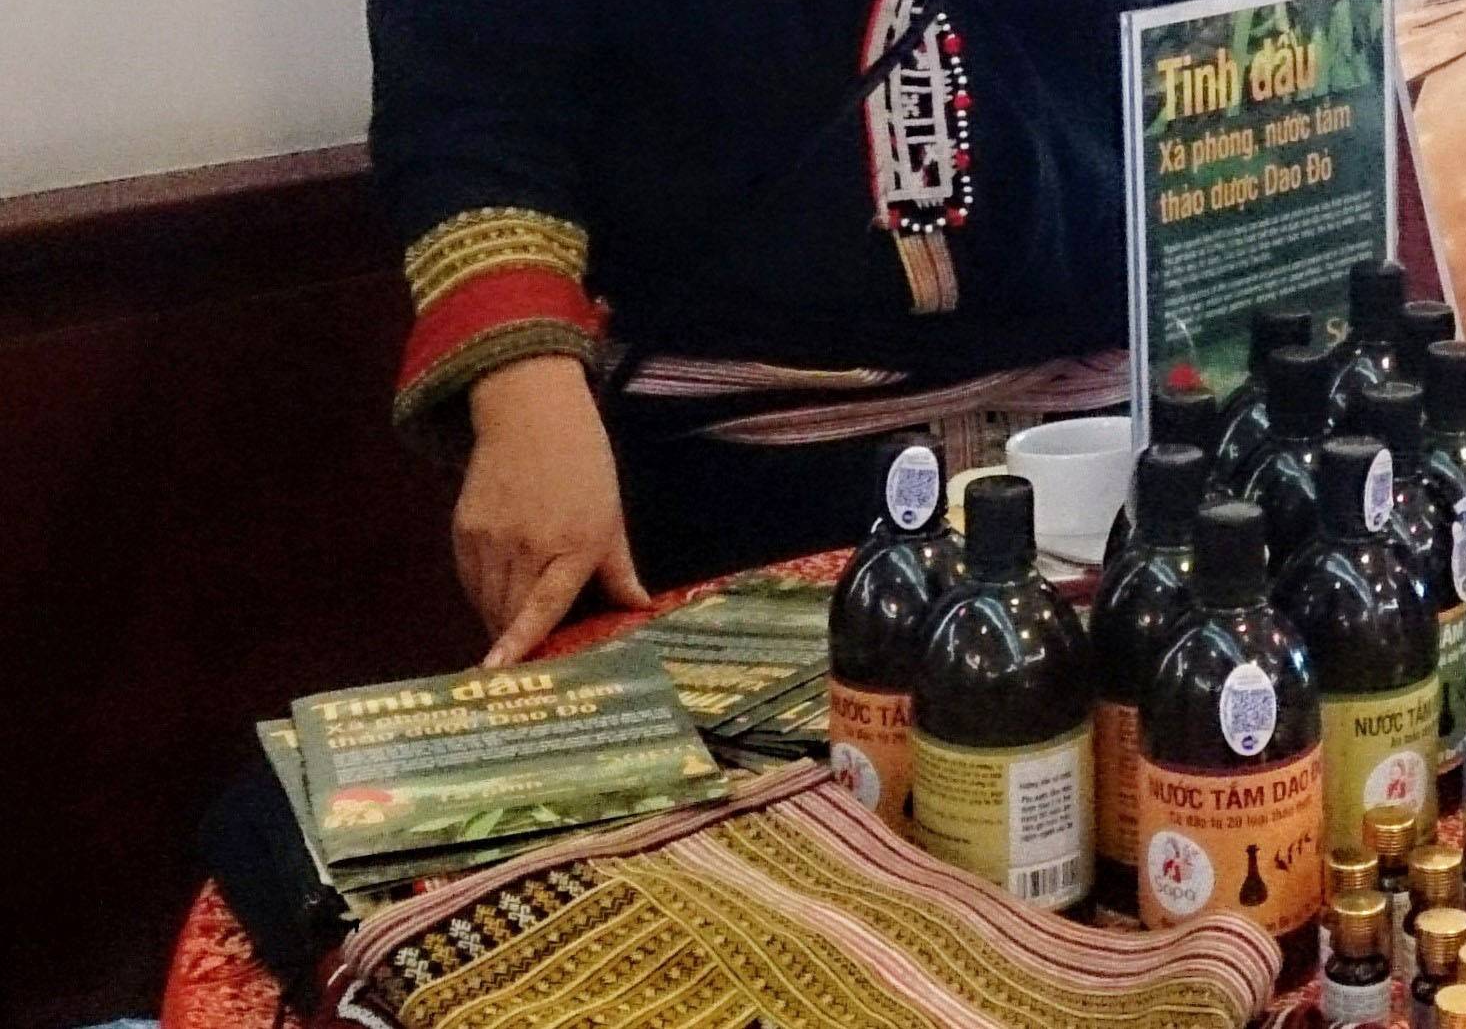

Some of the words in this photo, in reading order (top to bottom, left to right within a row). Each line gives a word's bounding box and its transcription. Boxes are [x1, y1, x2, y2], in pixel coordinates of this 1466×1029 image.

[1158, 47, 1239, 121] Tinh
[1160, 183, 1205, 224] thảo
[1211, 174, 1259, 211] dược
[1264, 163, 1301, 196] Dao
[311, 689, 434, 720] Tinh
[1211, 781, 1265, 811] TẮM
[1273, 770, 1309, 804] DAO
